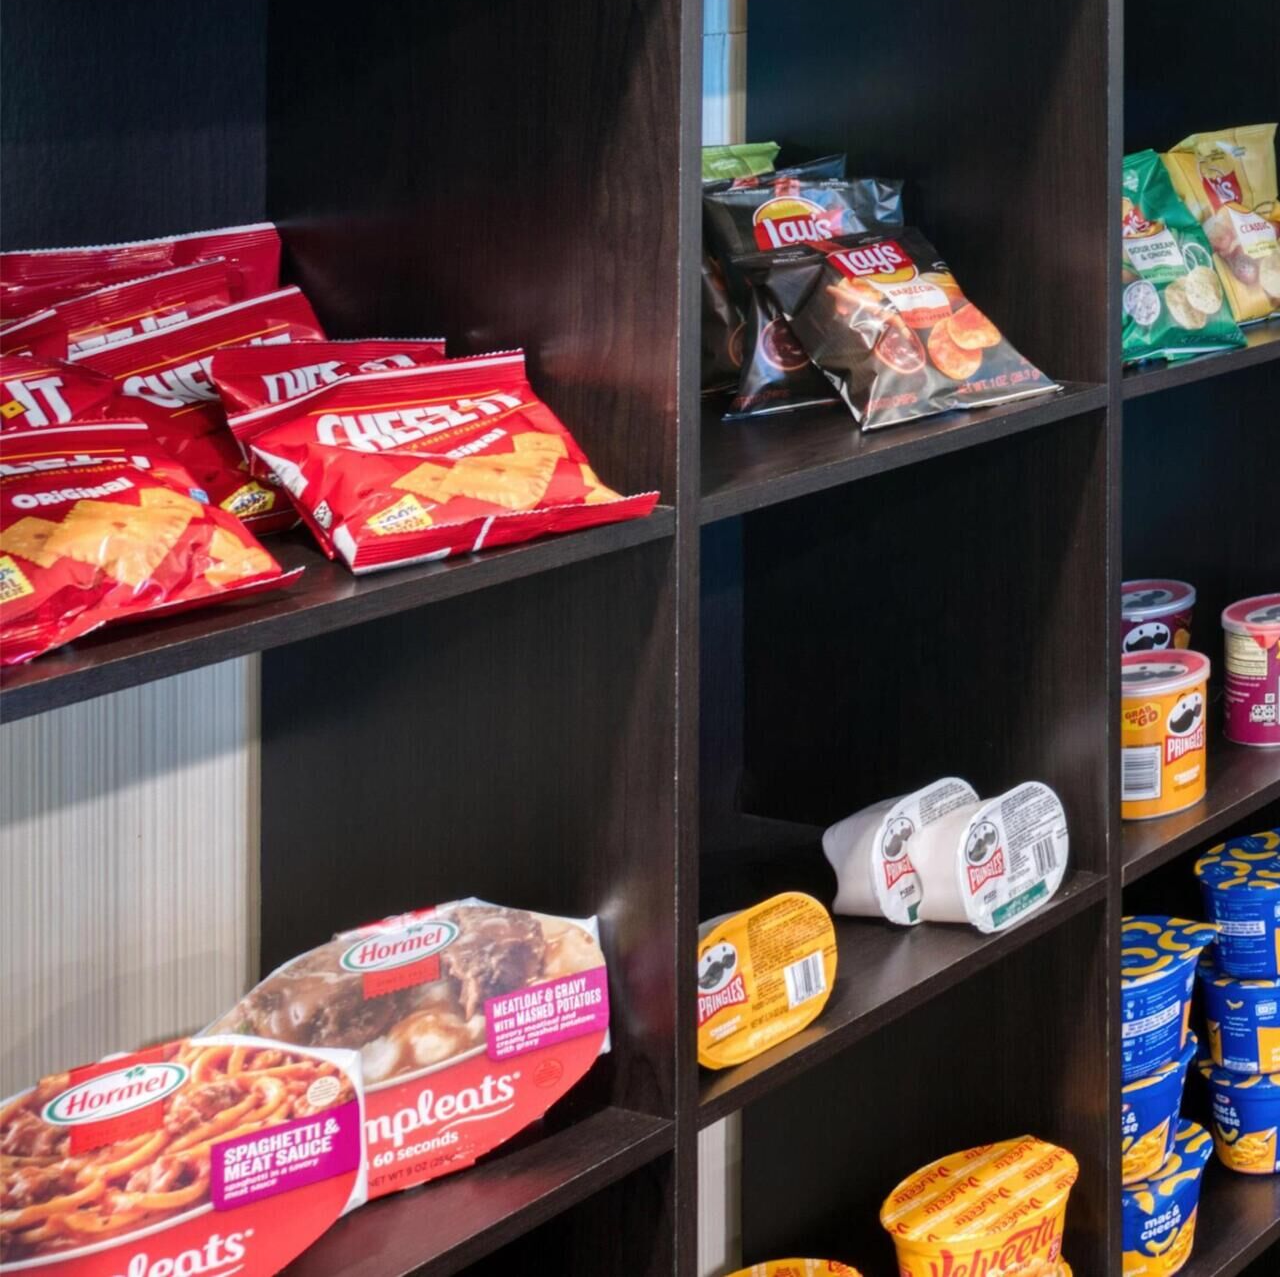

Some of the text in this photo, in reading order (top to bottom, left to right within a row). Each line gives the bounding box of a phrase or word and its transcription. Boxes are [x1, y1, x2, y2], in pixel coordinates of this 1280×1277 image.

[1241, 222, 1271, 234] CLASSIC
[835, 244, 903, 275] Lay's
[359, 927, 443, 964] Hormel
[493, 990, 543, 1019] MEATLOAF
[554, 978, 586, 1000] GRAVY
[516, 1002, 555, 1025] MASHED
[556, 988, 602, 1014] POTATOES
[698, 976, 745, 1023] PRINGLES
[66, 1071, 168, 1116] Hormel
[364, 1074, 516, 1147] mpleats
[224, 1118, 339, 1166] SPAGHETTI &
[224, 1135, 332, 1183] MEAT SAUCE
[373, 1130, 459, 1167] 60 seconds
[414, 1162, 428, 1173] OZ
[925, 1176, 980, 1215] Velveeta
[954, 1186, 1012, 1226] Velveeta
[127, 1233, 246, 1277] leats
